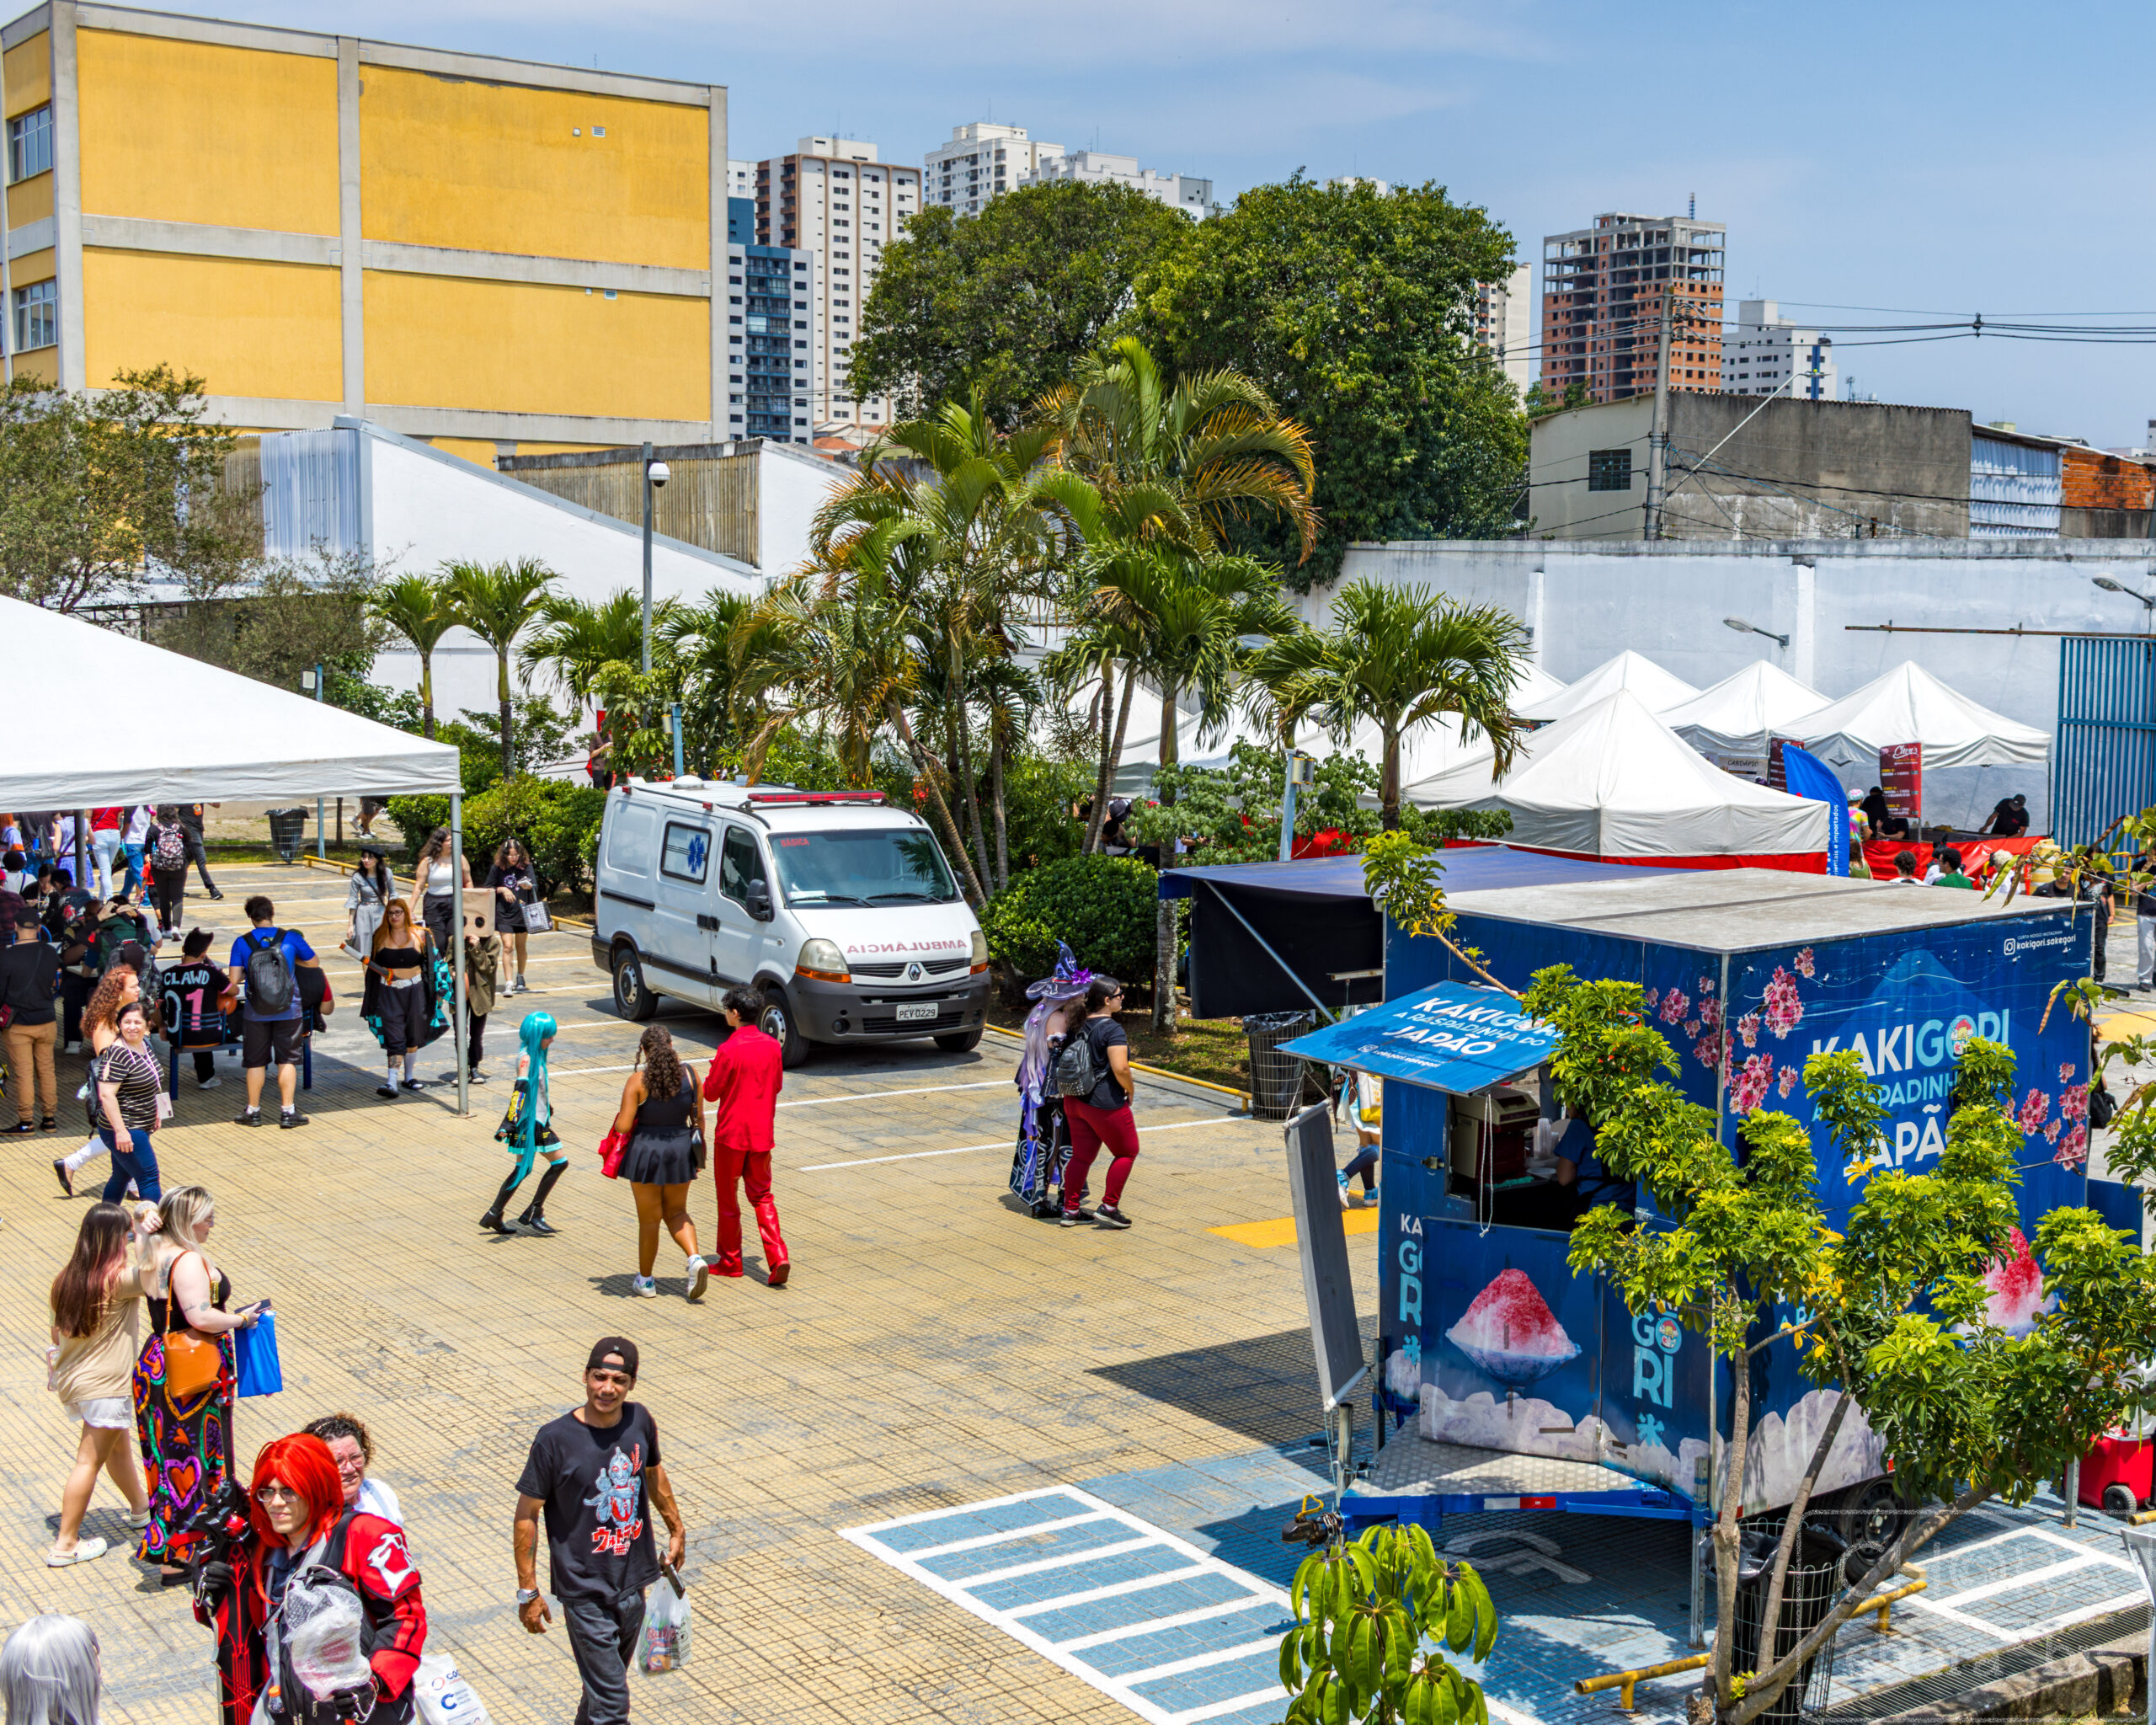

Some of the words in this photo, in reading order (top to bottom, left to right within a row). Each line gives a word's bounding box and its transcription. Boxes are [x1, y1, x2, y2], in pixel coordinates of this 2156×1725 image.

[2016, 934, 2076, 950] kakigori.sakegori
[163, 969, 210, 985] CLAWD
[1381, 1026, 1497, 1055] JAPÃO
[1407, 1013, 1517, 1041] RASPADINHA
[1518, 1037, 1546, 1046] DO
[1634, 1345, 1673, 1409] RI
[591, 1519, 643, 1553] ウルトラン
